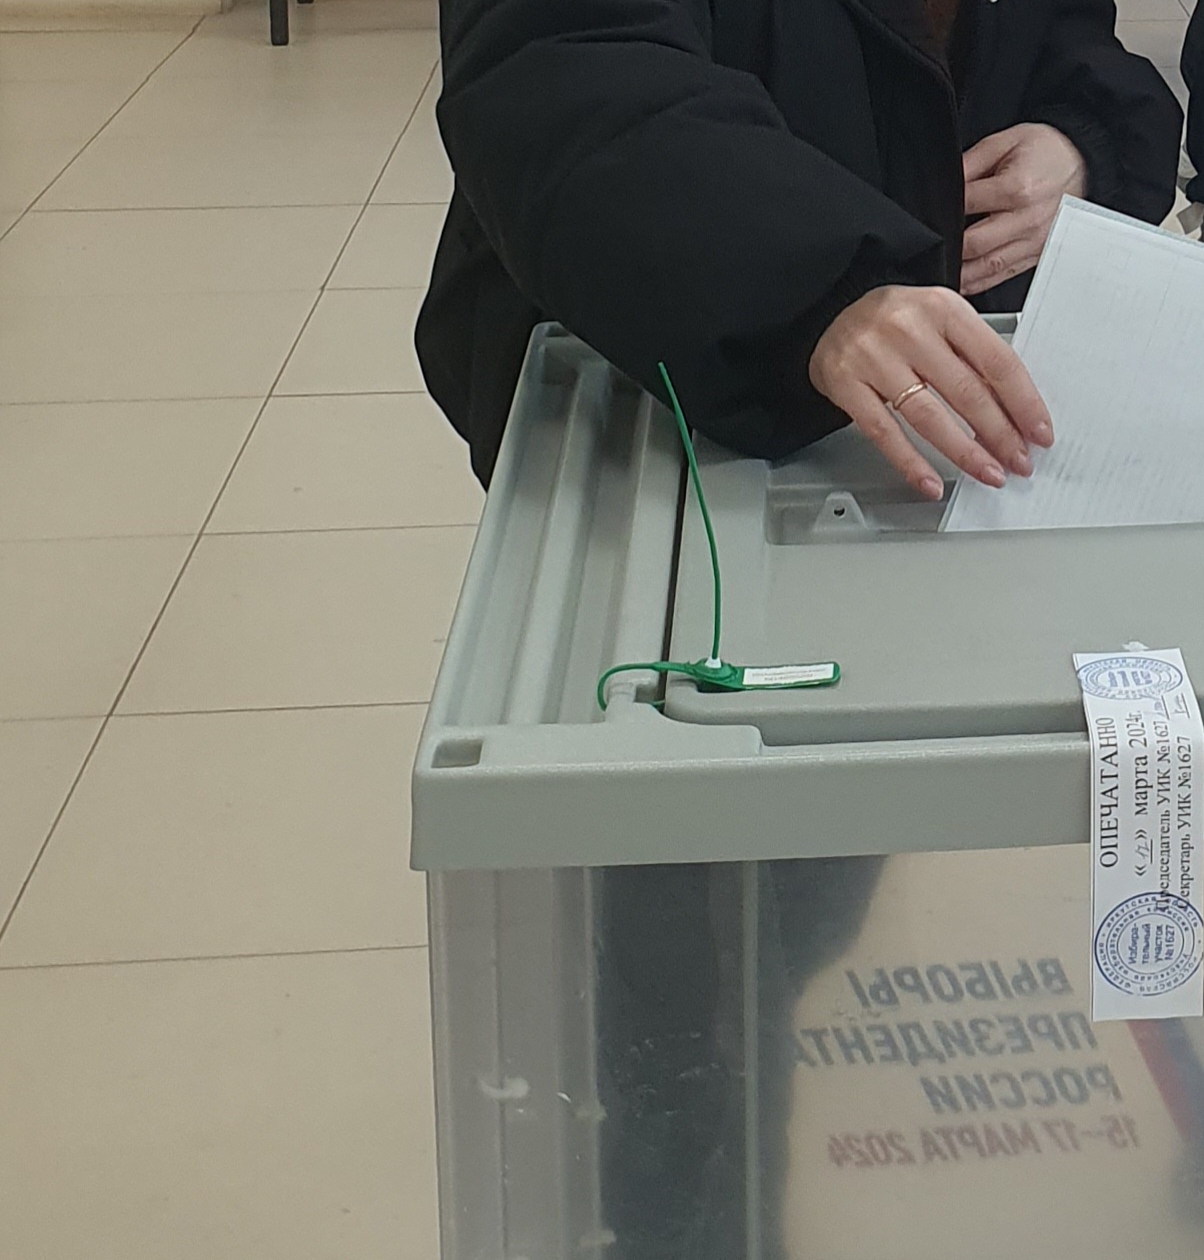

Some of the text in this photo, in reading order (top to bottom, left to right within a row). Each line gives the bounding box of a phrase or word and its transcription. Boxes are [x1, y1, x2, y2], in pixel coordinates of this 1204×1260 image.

[1154, 720, 1171, 764] №1627
[1177, 736, 1191, 789] №1627
[1095, 717, 1119, 869] ОПЕЧАТАННО
[1134, 754, 1153, 816] марта
[1157, 768, 1171, 805] УИК
[1177, 793, 1191, 831] УИК
[1164, 924, 1175, 961] №1627
